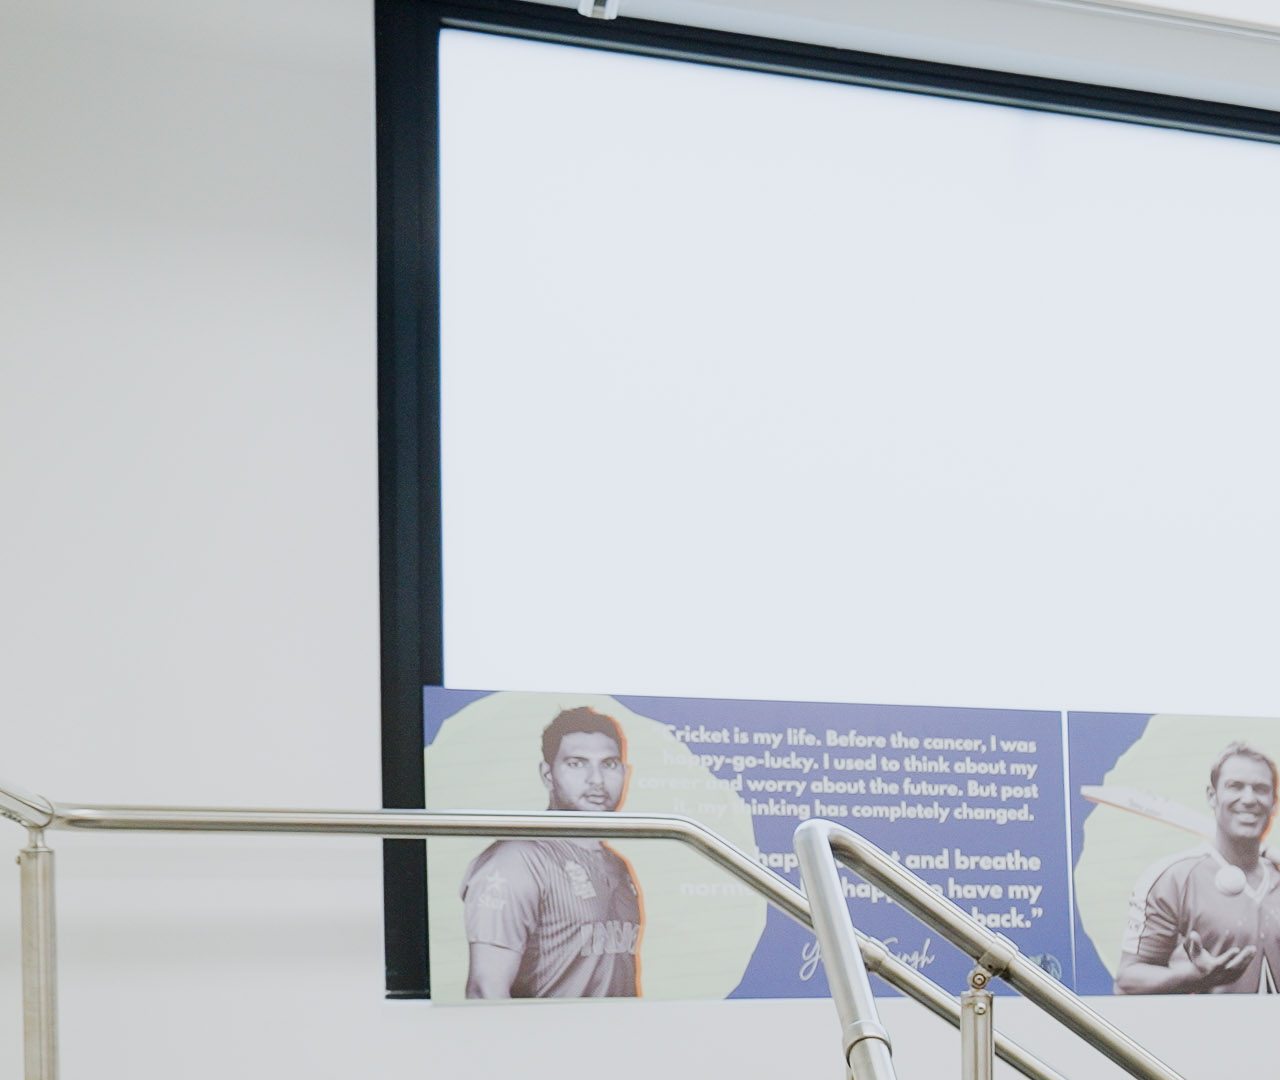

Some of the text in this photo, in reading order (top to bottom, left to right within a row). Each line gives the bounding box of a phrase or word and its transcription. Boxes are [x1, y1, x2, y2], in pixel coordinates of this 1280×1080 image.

[733, 727, 750, 745] is
[753, 732, 783, 750] my
[787, 727, 822, 748] life.
[826, 728, 887, 748] Before
[890, 731, 921, 749] the
[923, 736, 987, 753] cancer,
[990, 734, 997, 751] I
[1000, 740, 1038, 753] was
[664, 750, 1039, 780] happy-go-lucky. I used to think about my
[704, 774, 743, 791] and
[746, 778, 807, 796] worry
[810, 776, 866, 794] about
[869, 777, 899, 794] the
[903, 778, 964, 796] future.
[967, 780, 998, 798] But
[1001, 784, 1039, 801] post
[733, 799, 811, 820] thinking
[814, 800, 849, 817] has
[851, 801, 950, 823] completely
[953, 803, 1035, 825] changed.
[905, 848, 949, 870] and
[955, 849, 1042, 871] breathe
[949, 878, 1004, 899] have
[1008, 885, 1042, 904] my
[971, 907, 1044, 928] back.”
